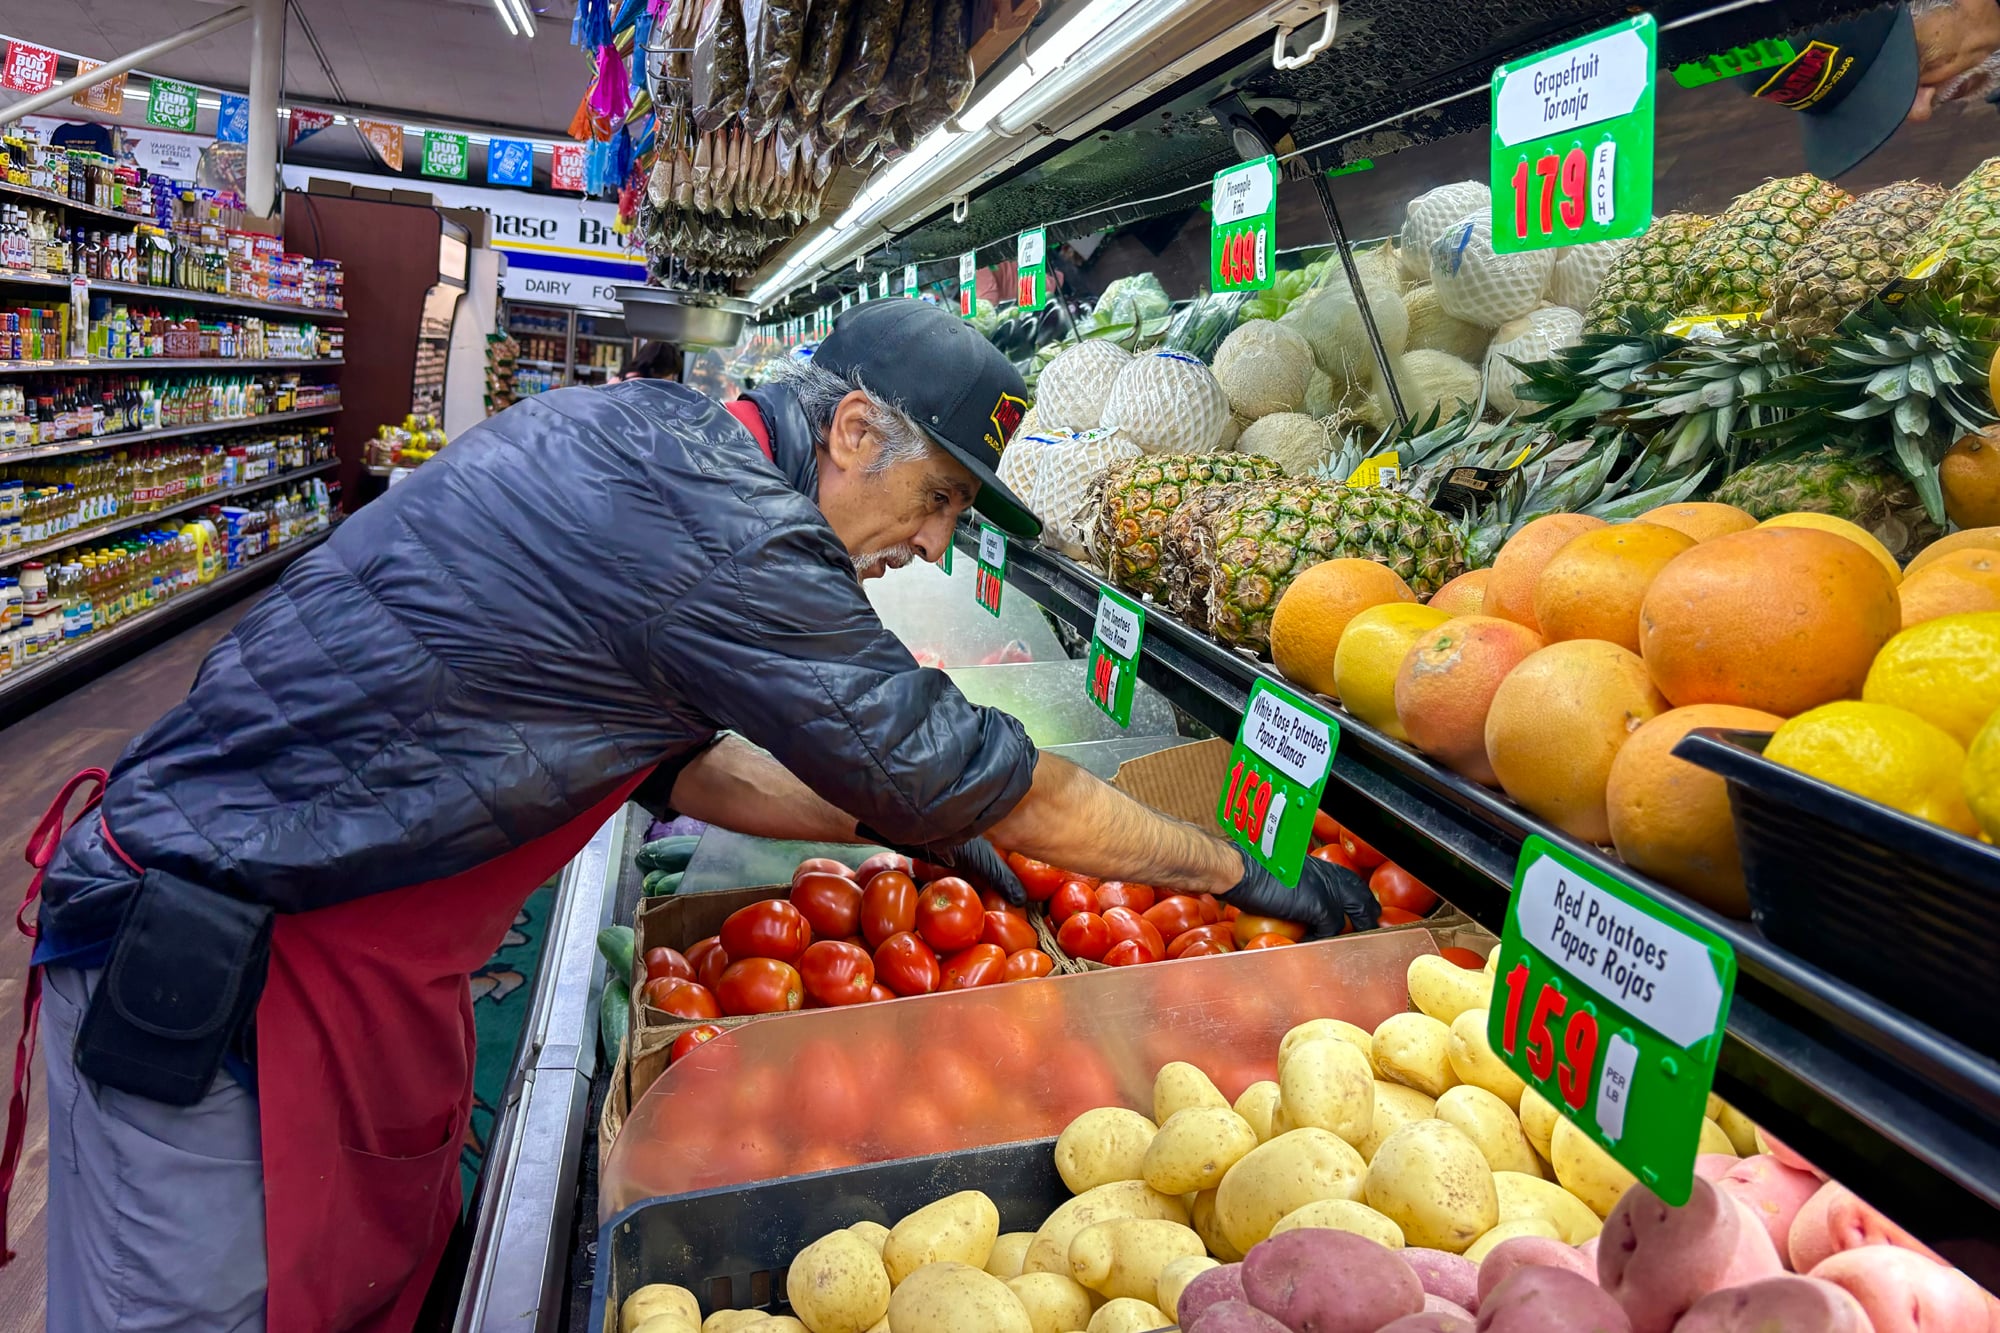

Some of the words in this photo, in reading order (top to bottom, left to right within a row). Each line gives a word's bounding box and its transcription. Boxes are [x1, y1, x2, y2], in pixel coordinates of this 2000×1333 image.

[10, 64, 48, 83] LIGHT
[15, 54, 46, 71] BUD
[1534, 52, 1599, 97] Grapefruit
[154, 101, 191, 117] LIGHT
[159, 91, 189, 105] BUD
[1543, 87, 1589, 122] Toronja
[150, 142, 176, 151] VAMOS
[428, 152, 463, 166] LIGHT
[432, 141, 459, 155] BUD
[1226, 174, 1252, 198] Pineapple
[1512, 148, 1587, 238] 179
[1597, 148, 1608, 216] EACH
[1220, 231, 1255, 285] 499
[525, 279, 572, 295] DAIRY
[592, 286, 616, 300] FO
[1253, 695, 1273, 722] White
[1272, 707, 1290, 733] Rose
[1292, 717, 1328, 755] Potatoes
[1256, 721, 1278, 751] Papas
[1276, 738, 1307, 769] Blancas
[1223, 761, 1272, 845] 159
[1553, 879, 1584, 920] Red
[1585, 898, 1669, 972] Potatoes
[1551, 915, 1599, 968] Papas
[1600, 953, 1657, 1003] Rojas
[1504, 962, 1599, 1111] 159
[1606, 1065, 1626, 1089] PER
[1604, 1084, 1620, 1104] LB
